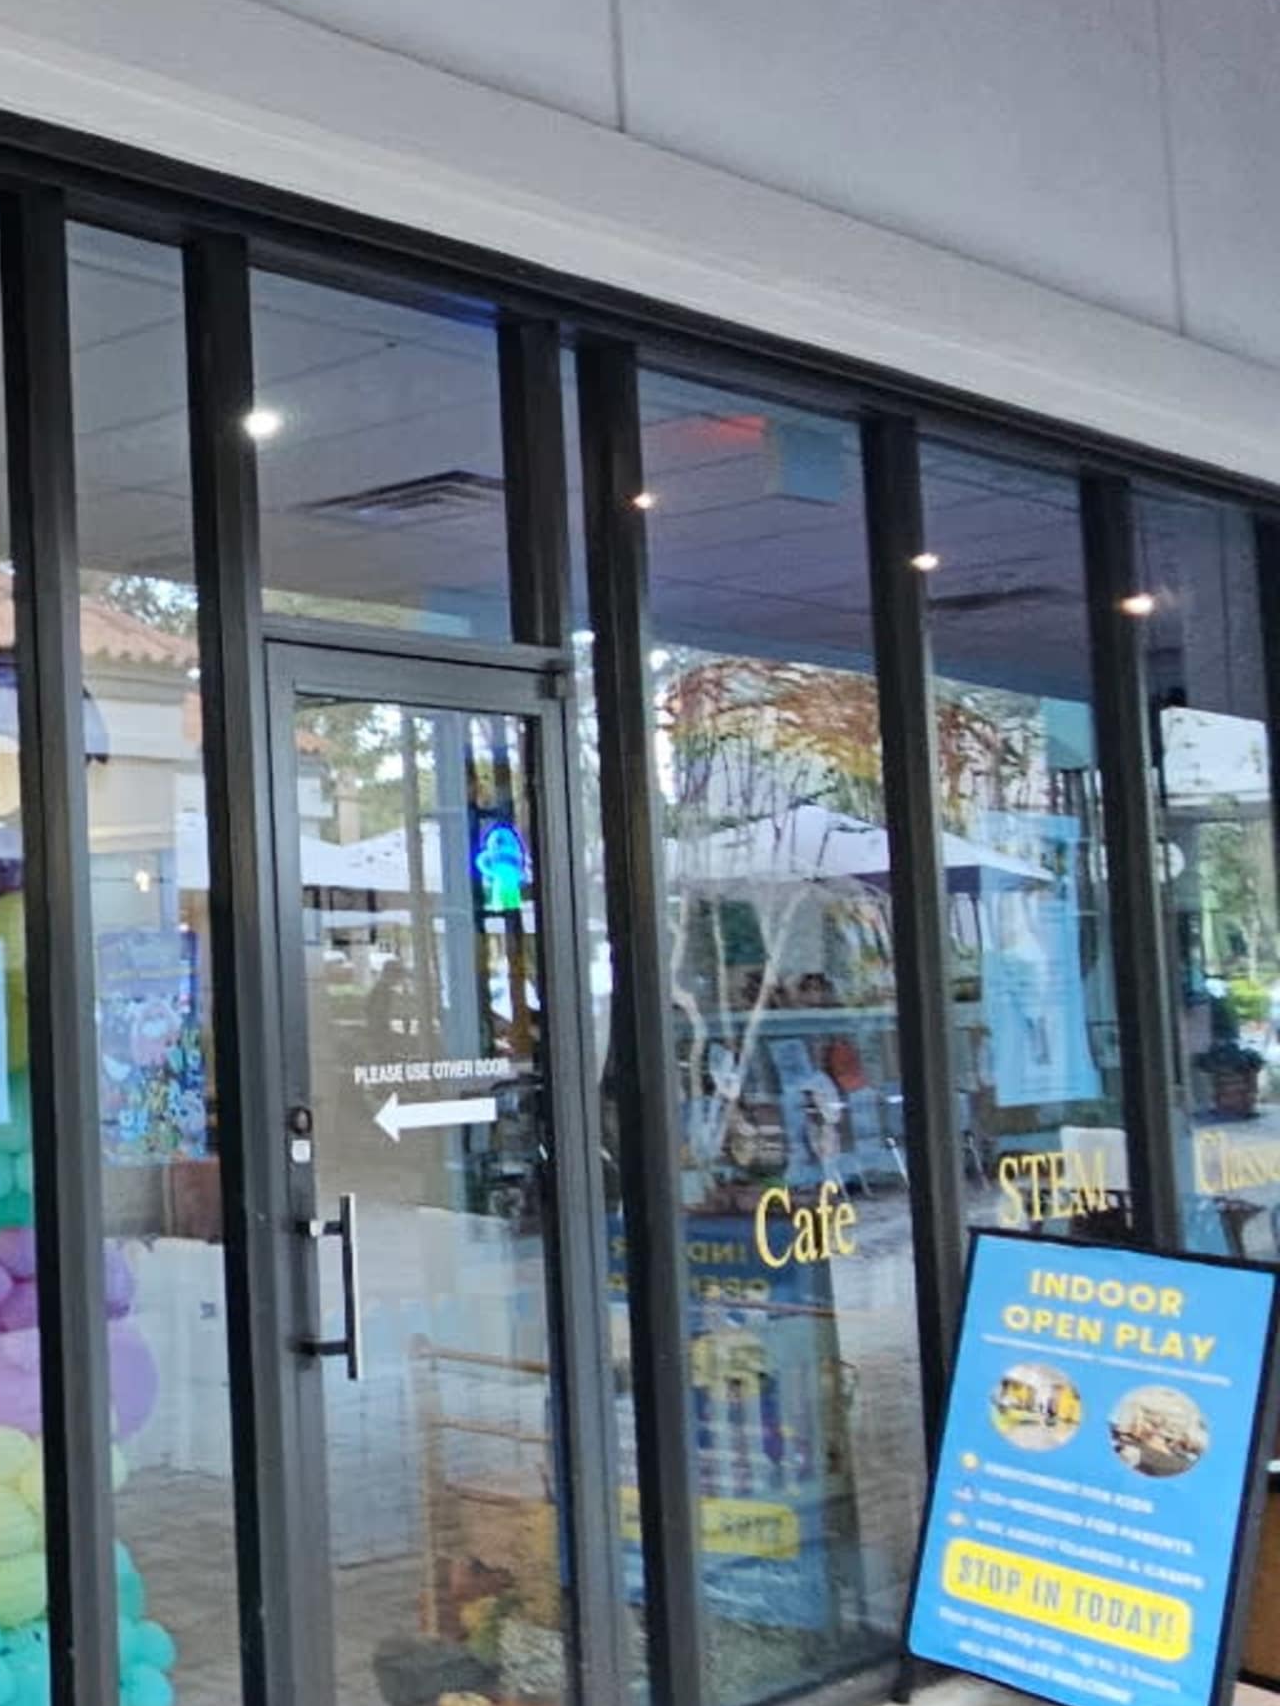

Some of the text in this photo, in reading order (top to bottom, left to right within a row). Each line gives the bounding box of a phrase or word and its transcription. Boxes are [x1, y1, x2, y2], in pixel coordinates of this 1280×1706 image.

[354, 1056, 510, 1085] PLEASE USE OTHER DOOR
[998, 1151, 1111, 1226] STEM
[755, 1180, 857, 1269] Cafe
[1030, 1269, 1184, 1318] INDOOR
[1002, 1304, 1216, 1363] OPEN PLAY
[958, 1555, 1176, 1643] STOP IN TODAY!
